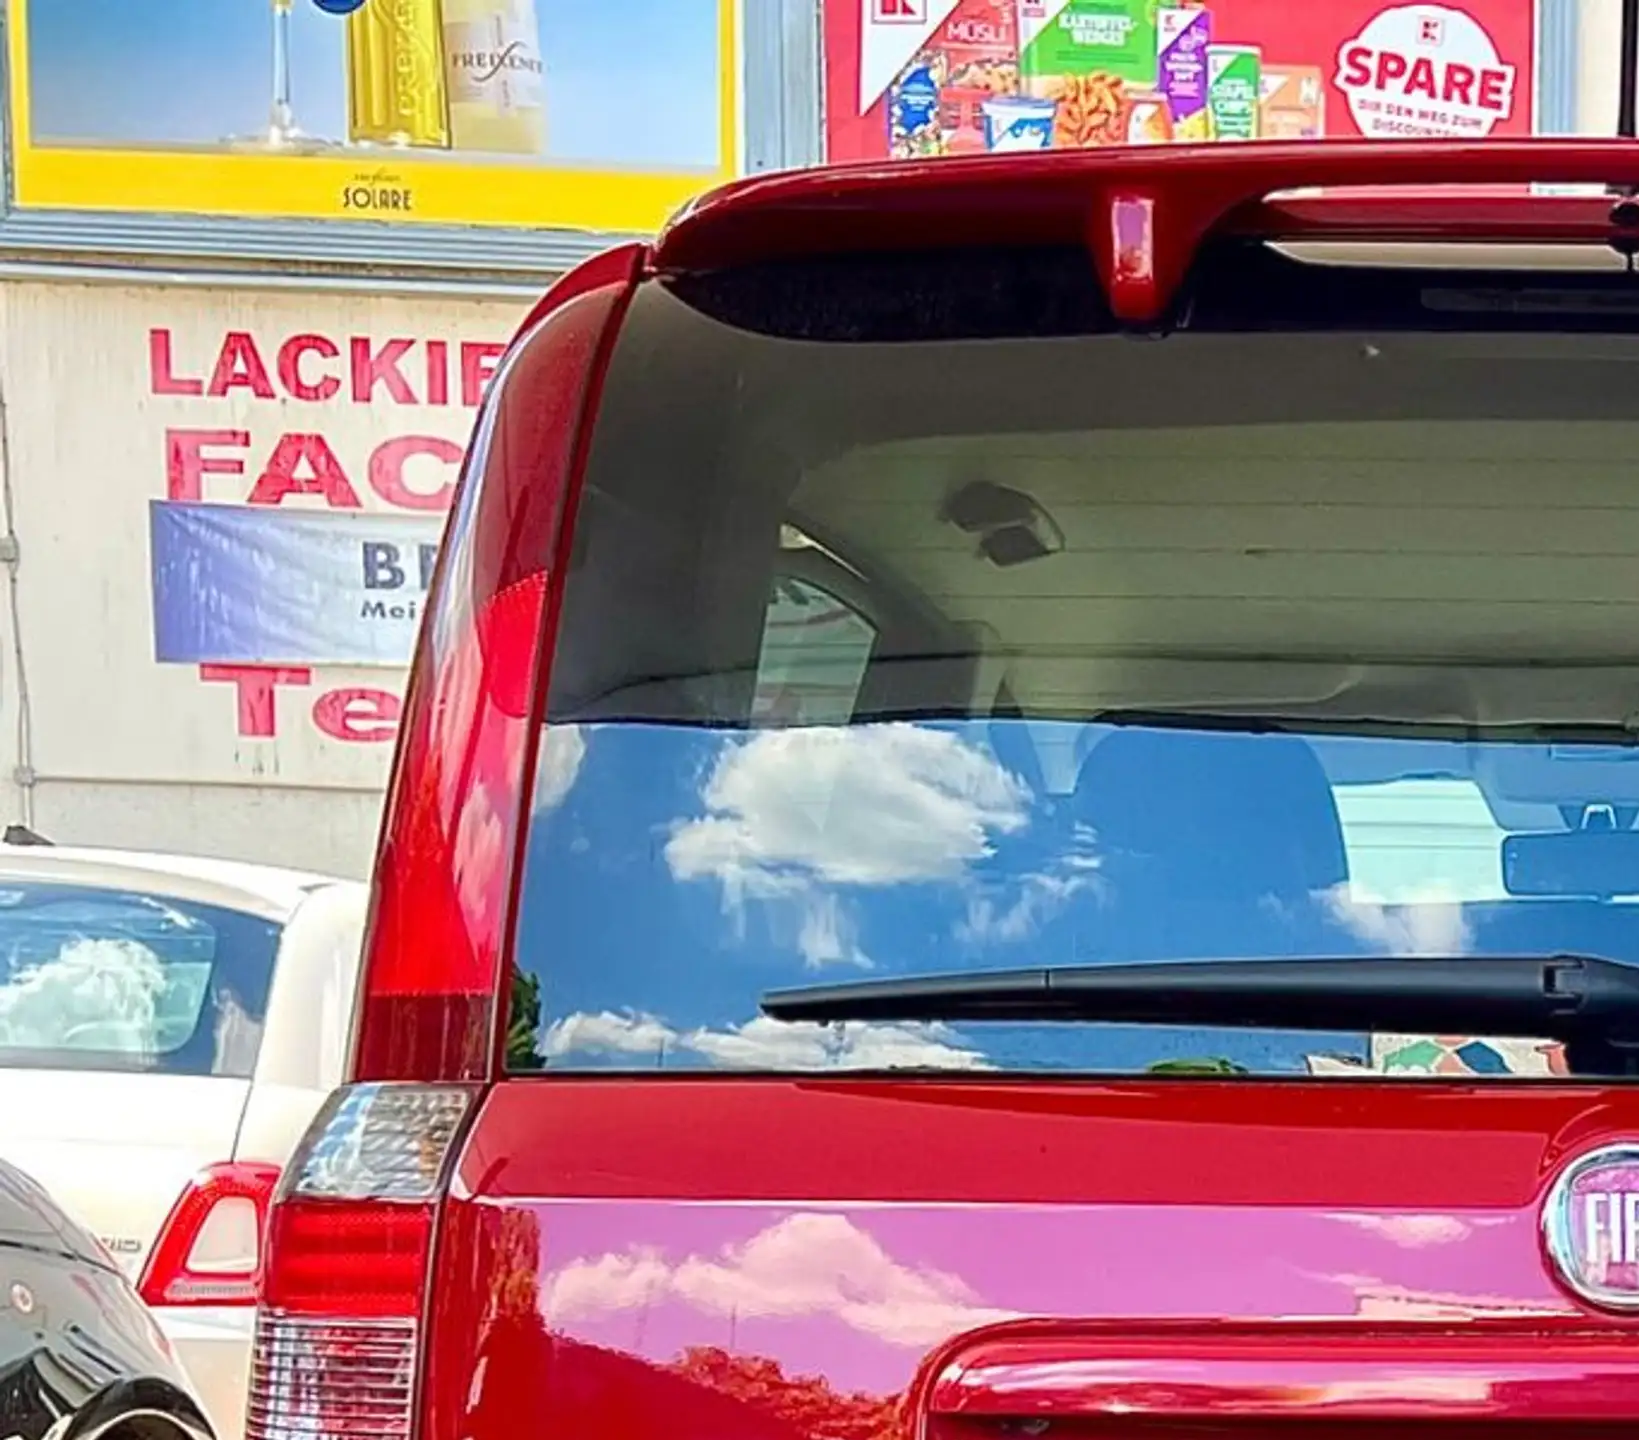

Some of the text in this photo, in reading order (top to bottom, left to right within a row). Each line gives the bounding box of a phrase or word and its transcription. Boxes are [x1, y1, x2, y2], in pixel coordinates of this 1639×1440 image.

[1344, 47, 1507, 111] SPARE
[1386, 102, 1414, 117] DEN
[343, 186, 412, 211] SOLARE
